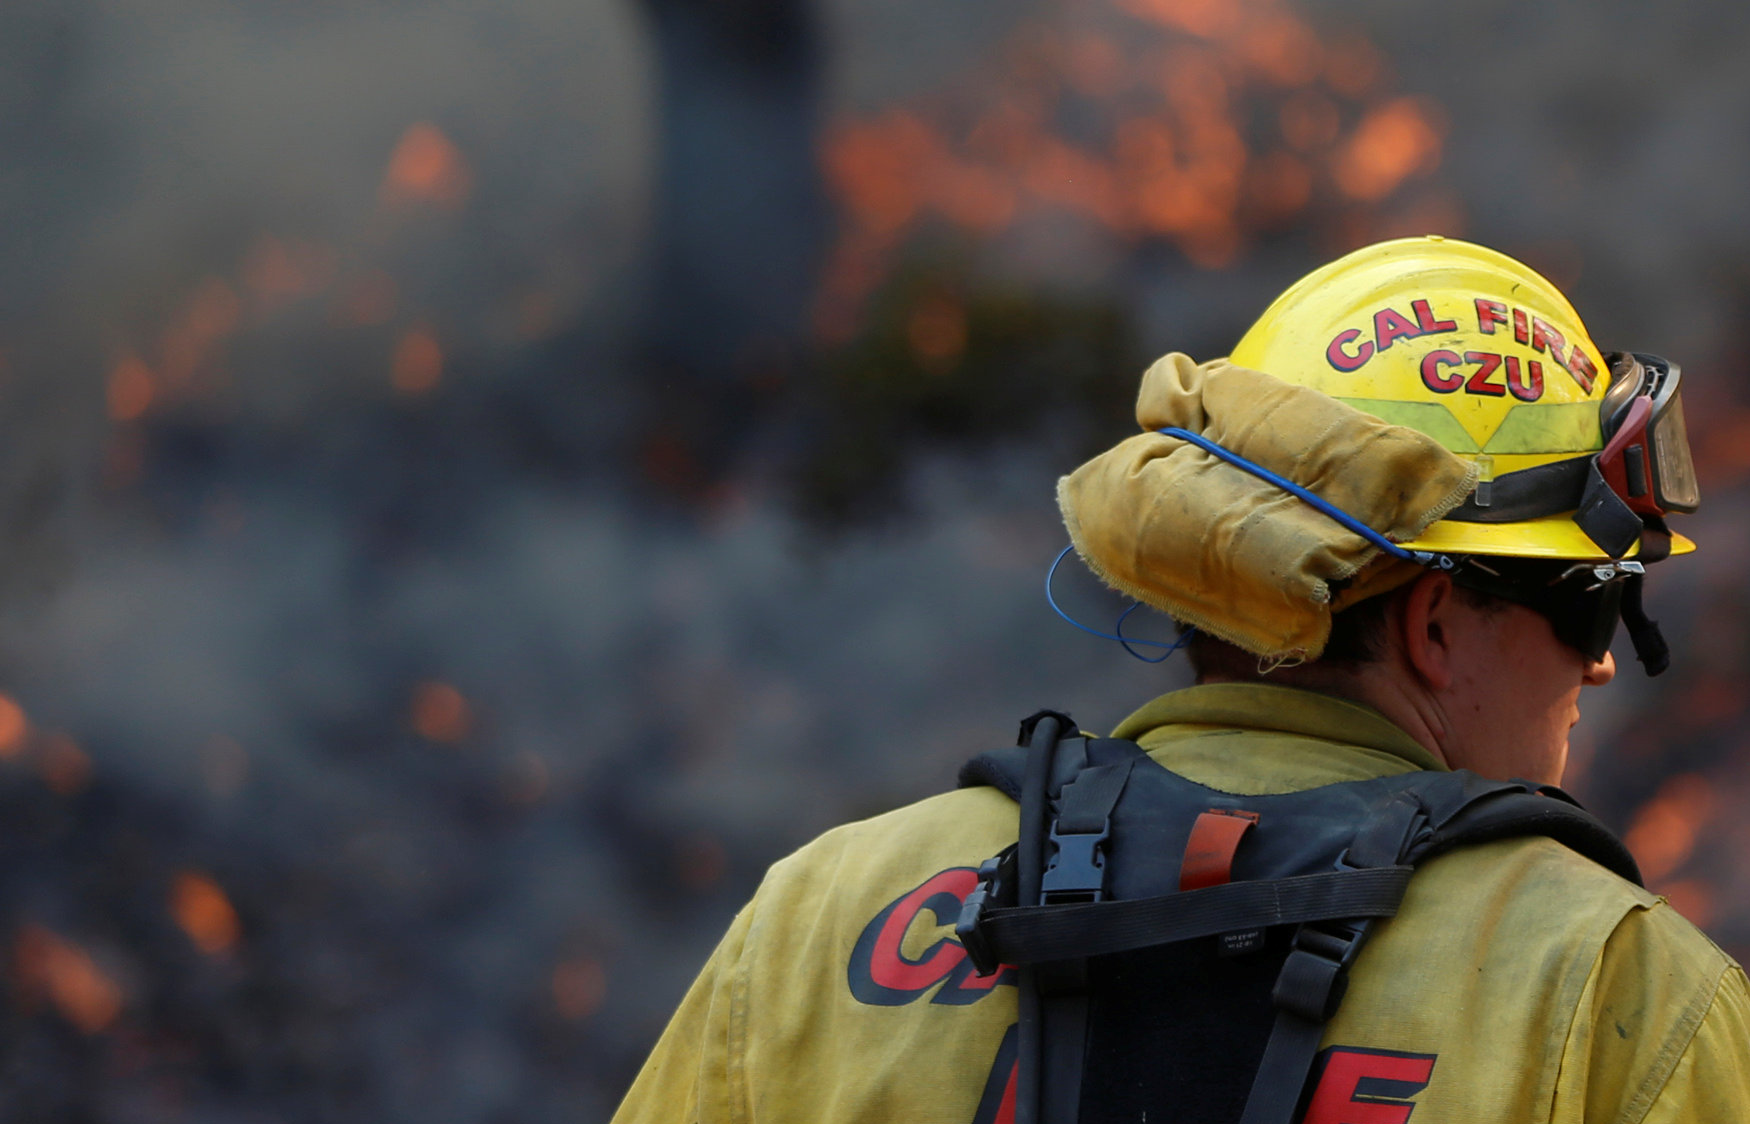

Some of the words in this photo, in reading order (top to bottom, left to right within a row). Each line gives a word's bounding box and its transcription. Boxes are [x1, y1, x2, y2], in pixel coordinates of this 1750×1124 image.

[1326, 298, 1458, 373] CAL
[1474, 298, 1598, 396] FIRE
[1420, 349, 1544, 402] CZU
